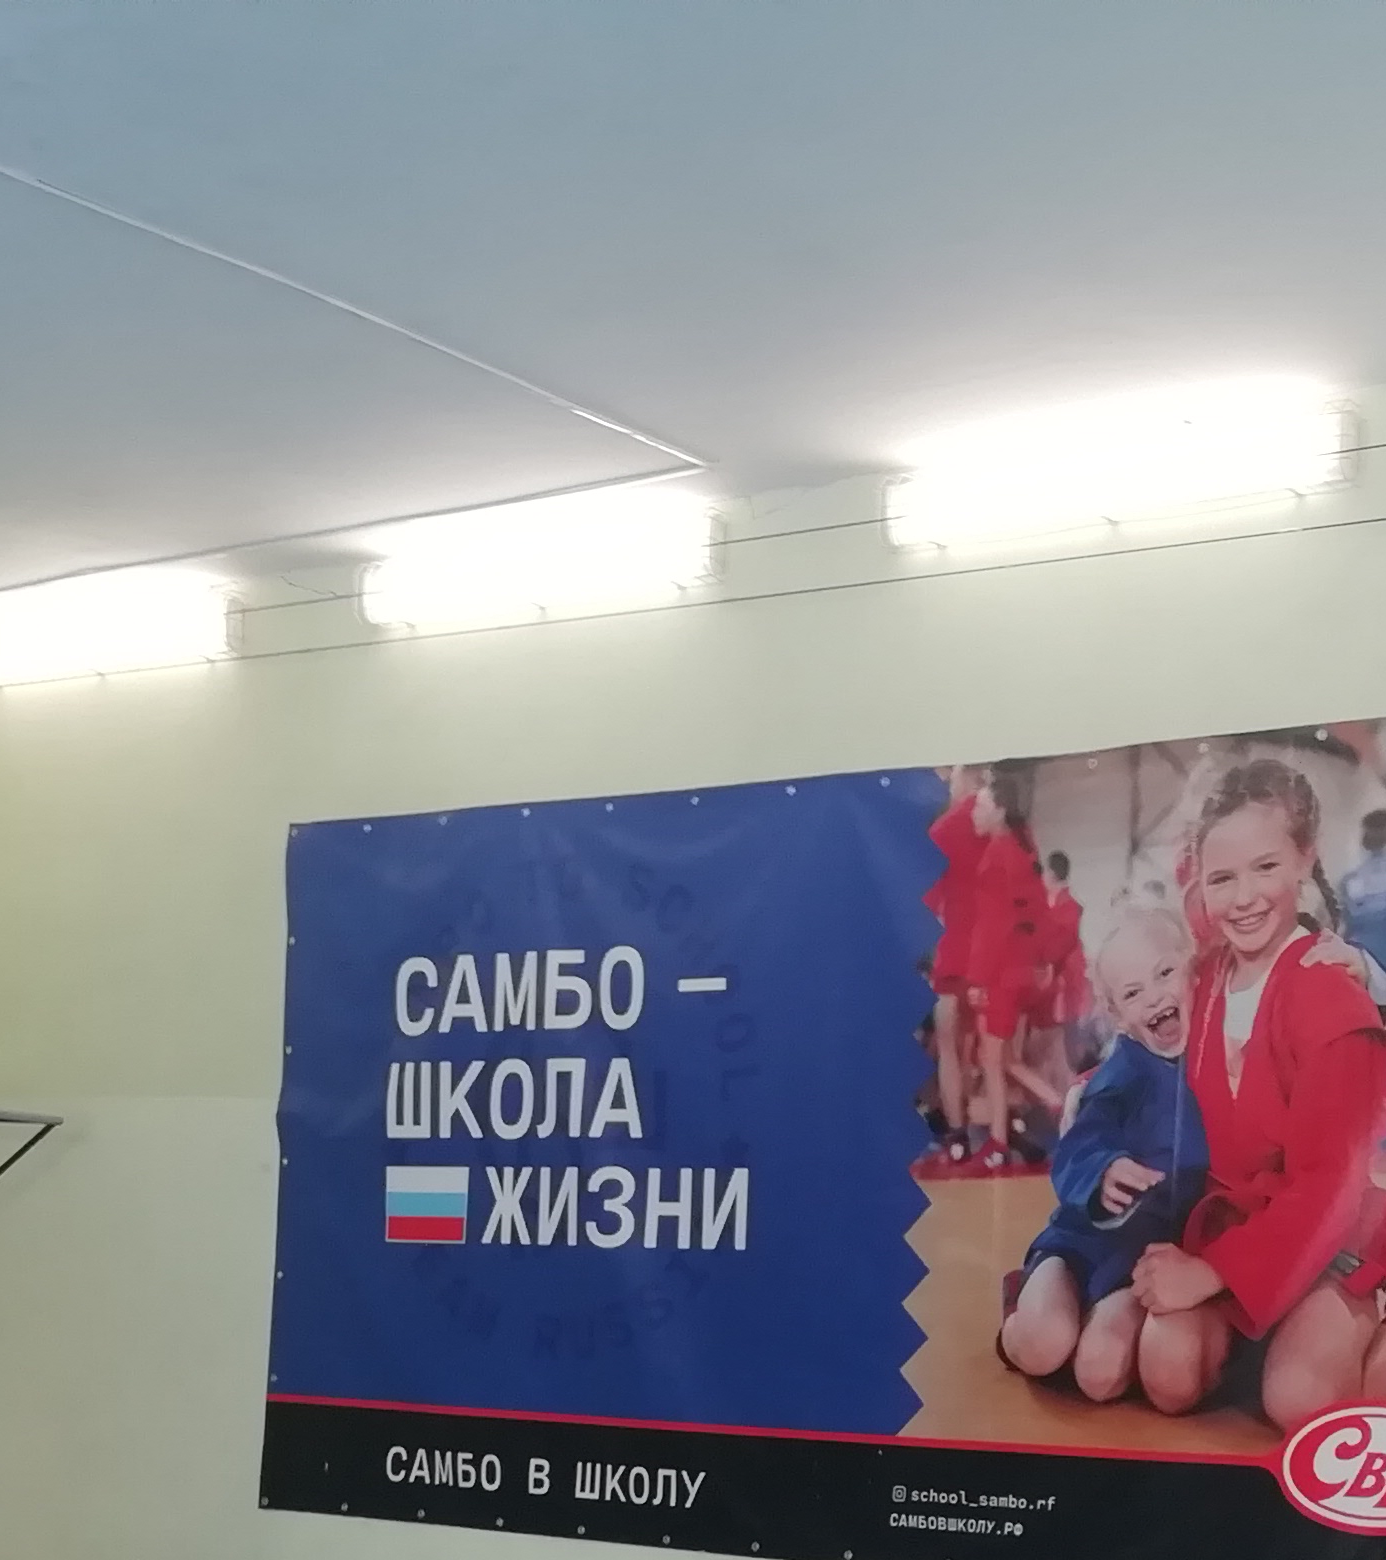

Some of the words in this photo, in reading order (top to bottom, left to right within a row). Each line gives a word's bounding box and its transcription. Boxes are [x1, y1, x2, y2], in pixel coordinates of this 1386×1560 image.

[395, 945, 645, 1037] САМБО
[385, 1057, 644, 1140] ШКОЛА
[481, 1165, 750, 1251] ЖИЗНИ
[385, 1445, 502, 1492] САМБО
[527, 1457, 551, 1495] В
[574, 1461, 707, 1509] ШКОЛУ
[911, 1488, 1056, 1511] school_sambo.rf
[889, 1512, 1024, 1537] САМБОВШКОЛУ.РФ
